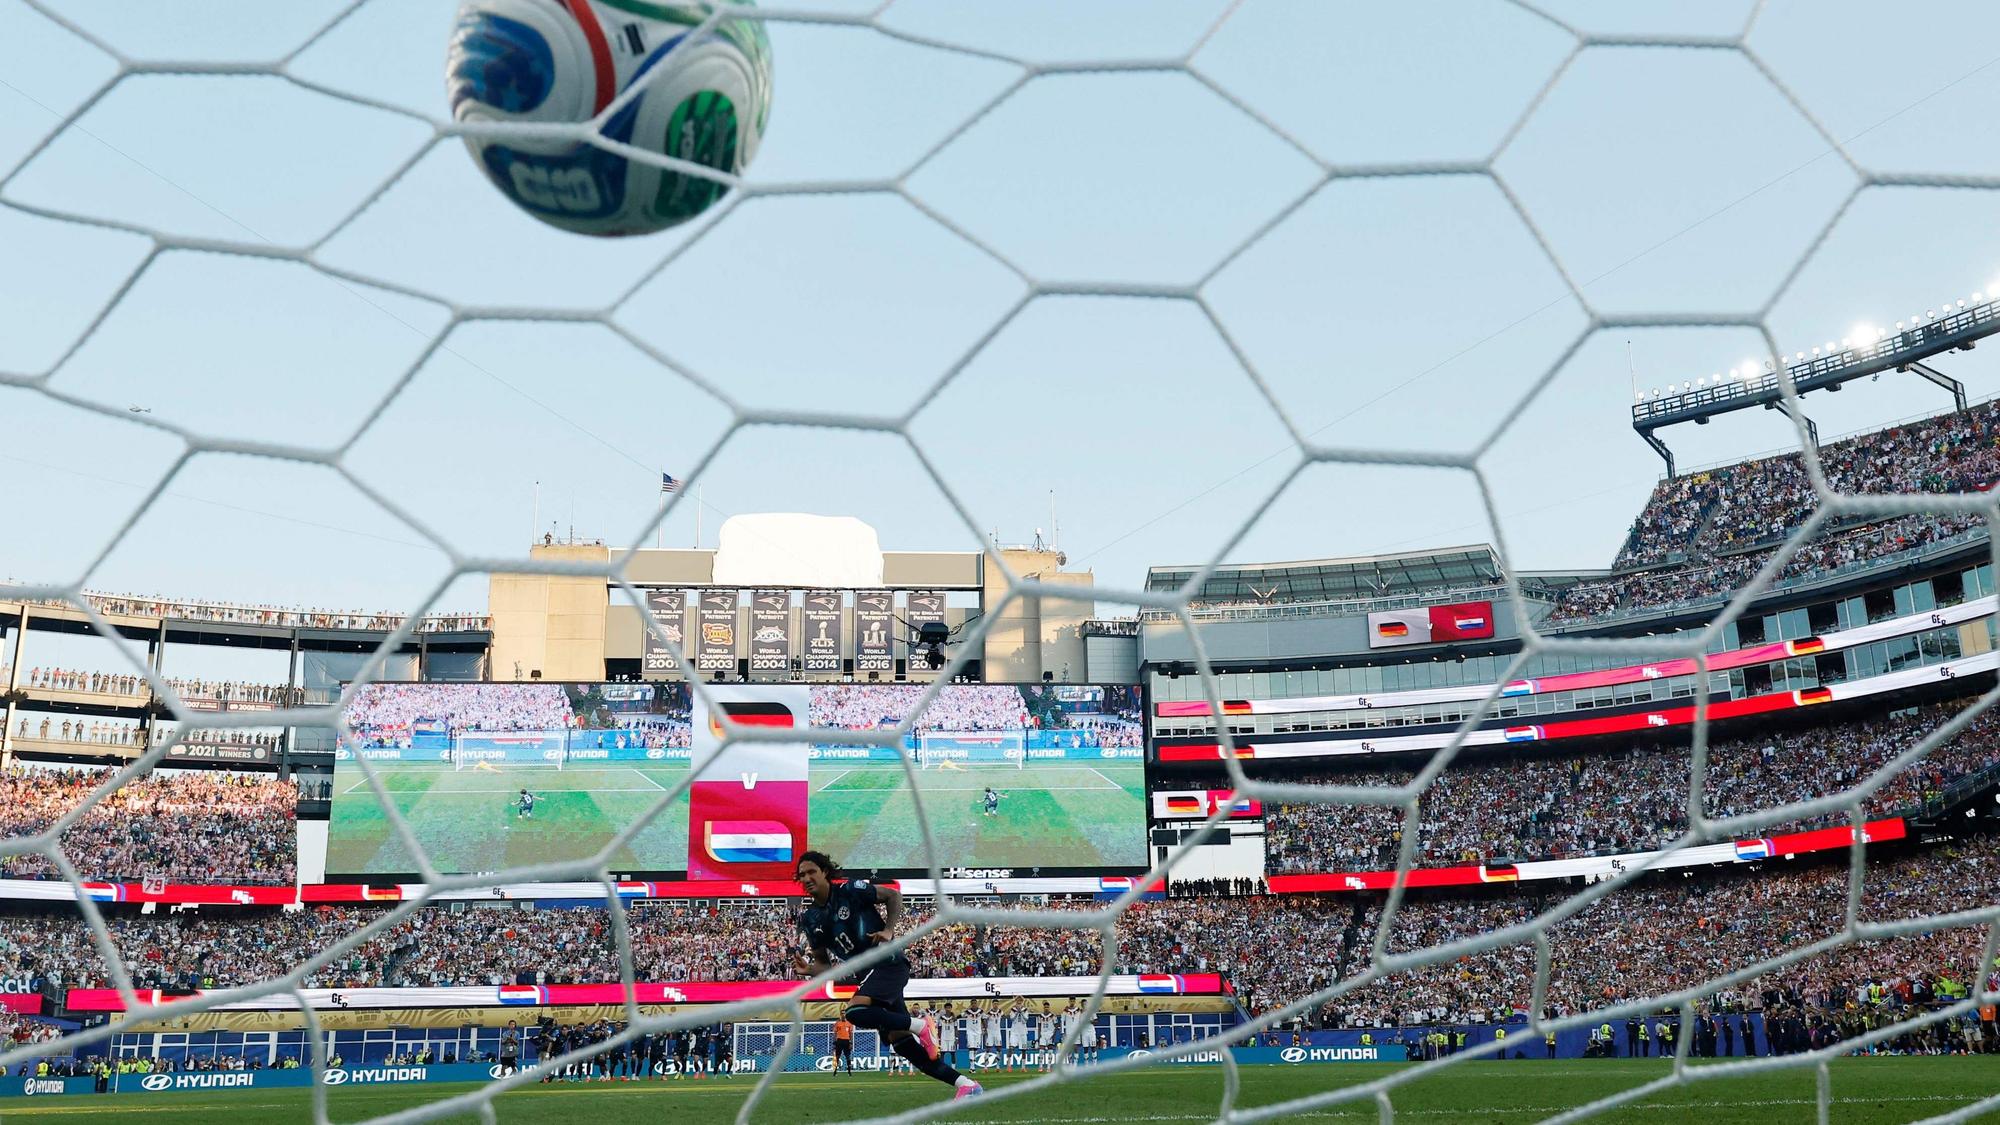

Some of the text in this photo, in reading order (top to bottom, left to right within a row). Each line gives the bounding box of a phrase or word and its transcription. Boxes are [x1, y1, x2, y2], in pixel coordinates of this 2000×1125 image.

[700, 660, 734, 668] 2003
[753, 660, 786, 668] 2004
[808, 660, 838, 668] 2014
[860, 660, 890, 668] 2016
[912, 660, 941, 668] 20
[188, 746, 215, 756] 2021
[218, 750, 251, 758] WINNERS
[950, 868, 1010, 878] Hisense
[146, 879, 163, 892] 79
[834, 932, 854, 954] 13
[1310, 1048, 1378, 1060] HYUNDAI
[1003, 1054, 1070, 1065] HYUND
[352, 1068, 426, 1082] HYUNDAI
[176, 1073, 254, 1088] HYUNDAI
[36, 1081, 64, 1093] HYUNDAI
